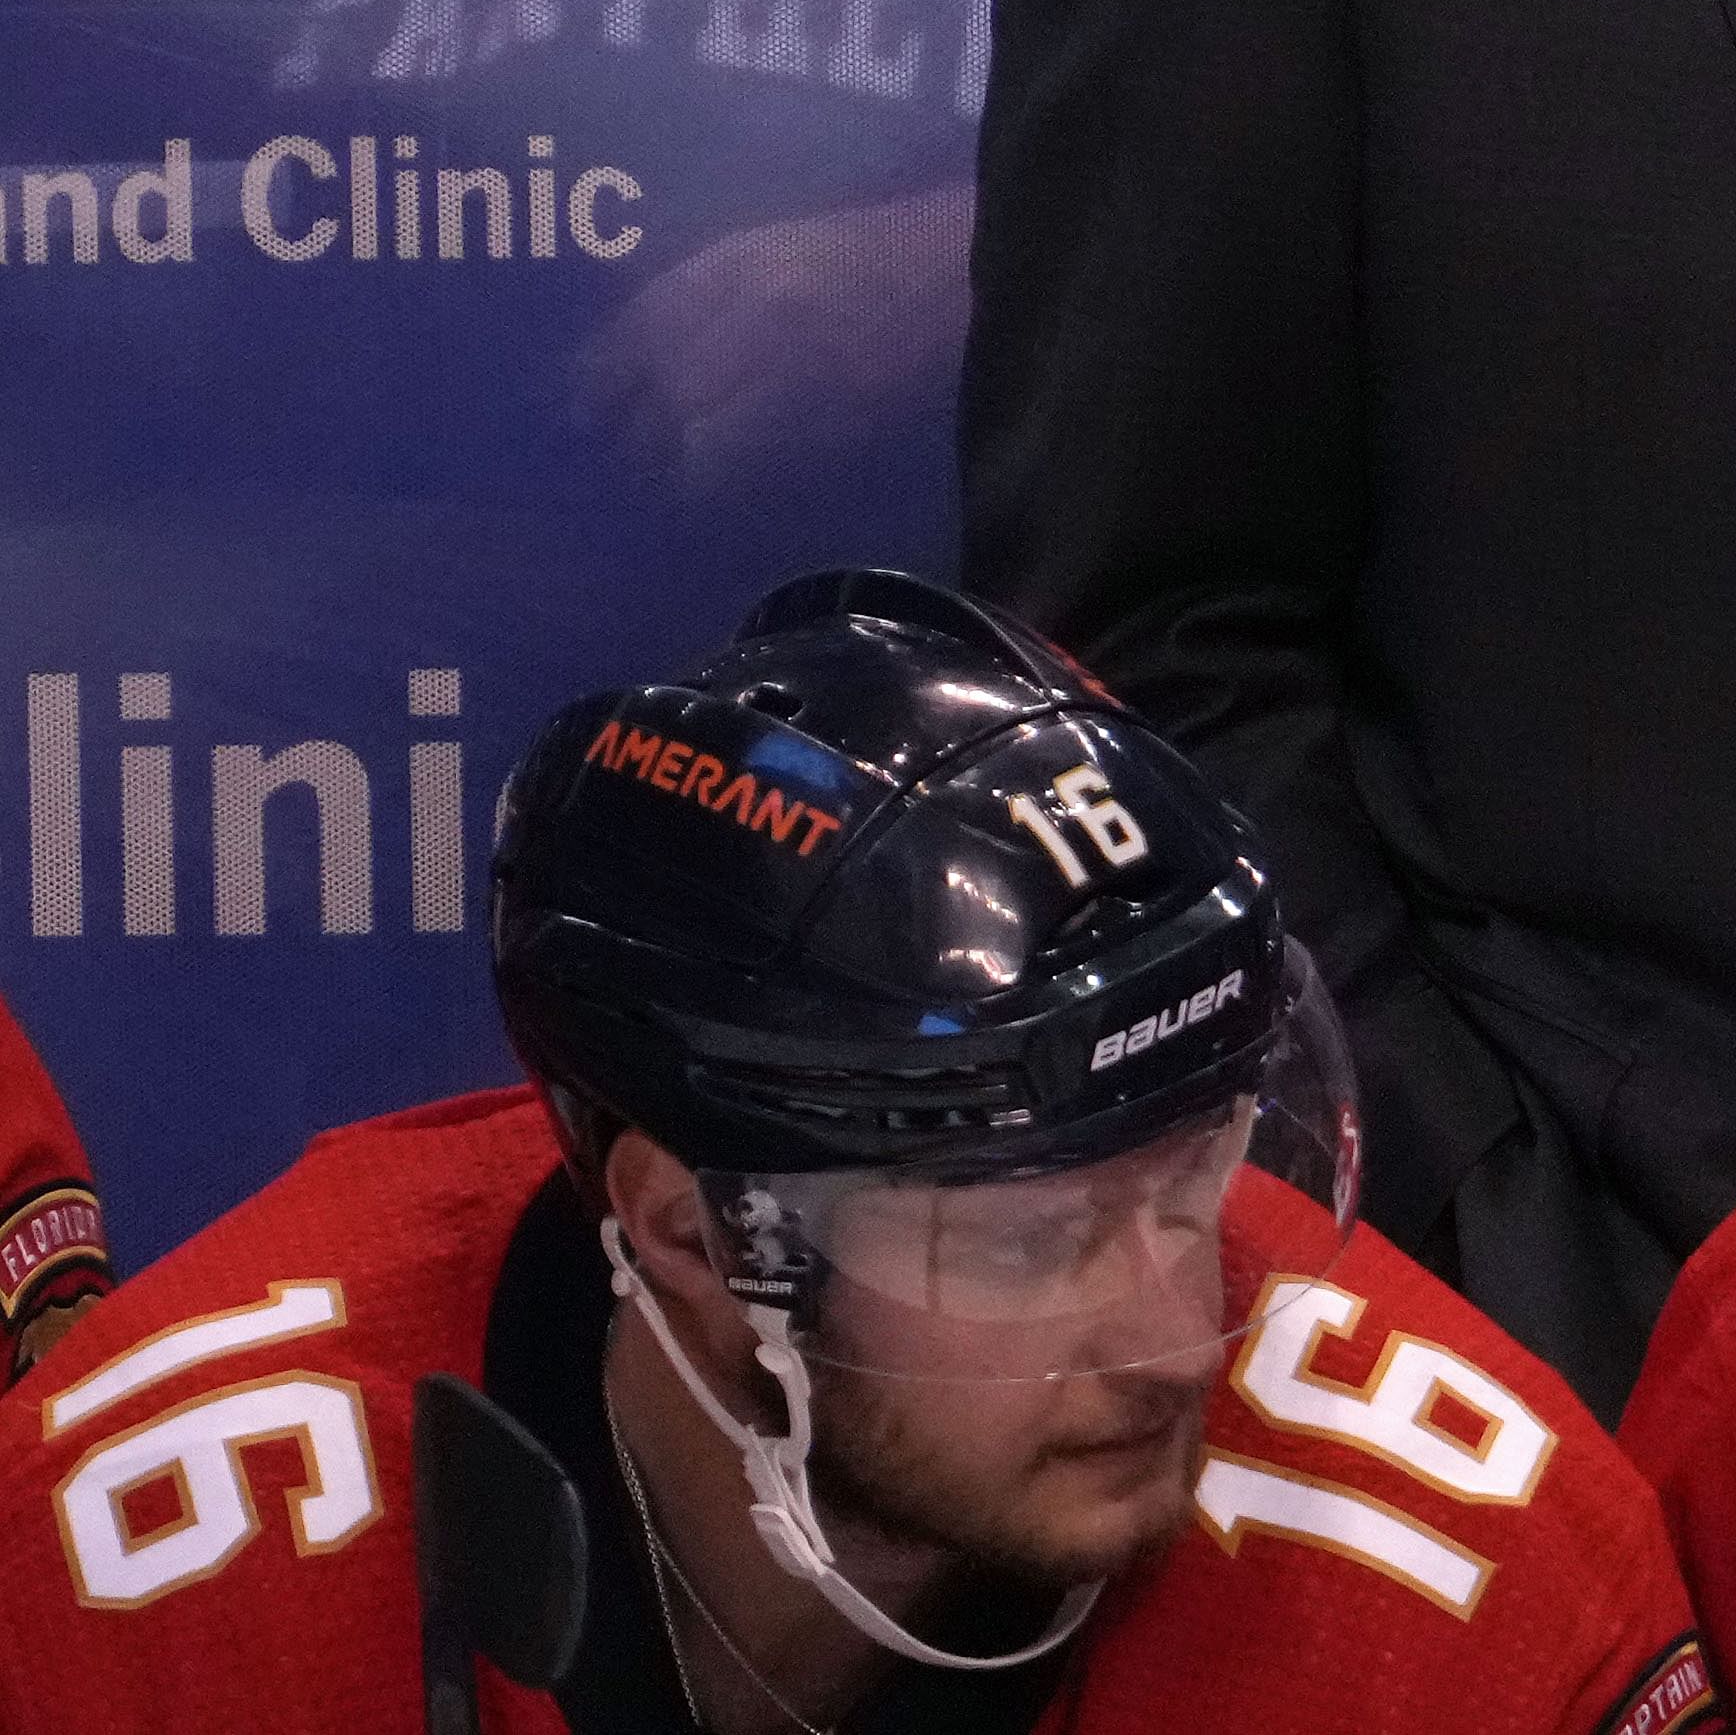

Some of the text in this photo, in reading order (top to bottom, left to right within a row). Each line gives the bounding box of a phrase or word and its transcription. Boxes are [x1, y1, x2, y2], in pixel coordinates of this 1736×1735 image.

[0, 132, 644, 264] nd Clinic
[588, 720, 843, 856] AMERANT
[1008, 762, 1150, 889] 16
[1089, 968, 1246, 1072] BAUER
[41, 1278, 384, 1611] 16
[1193, 1272, 1561, 1623] 16
